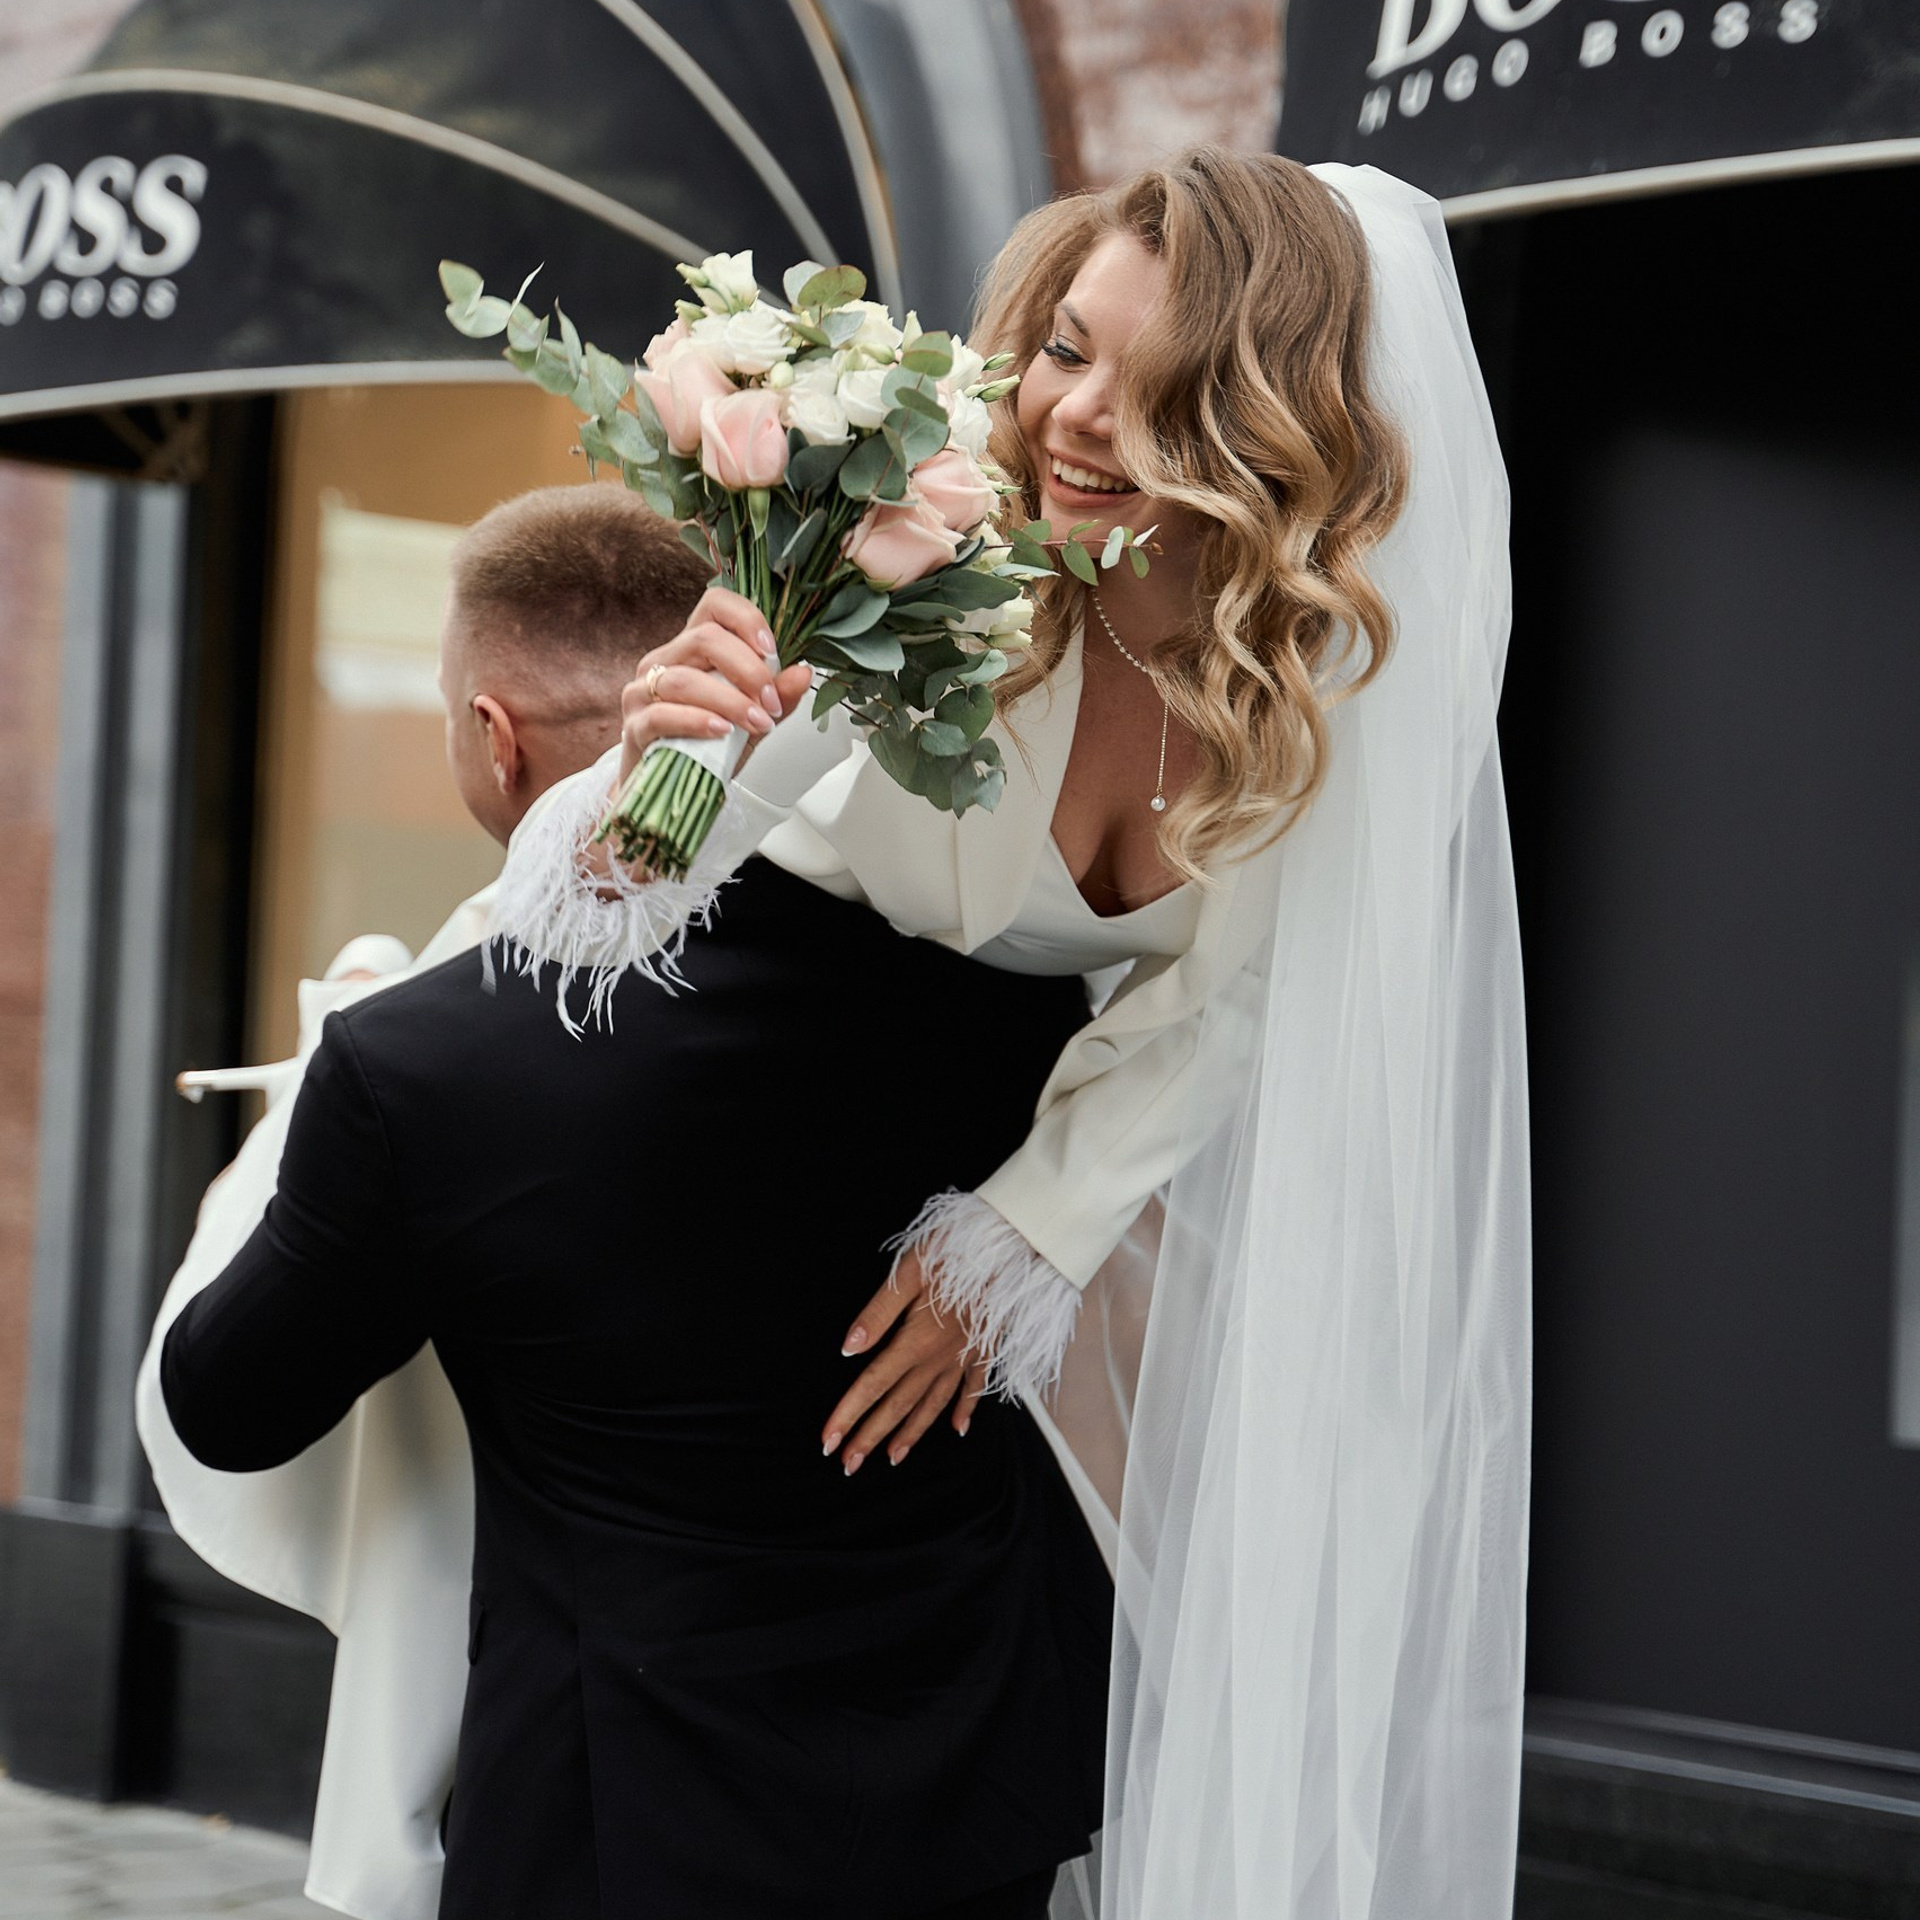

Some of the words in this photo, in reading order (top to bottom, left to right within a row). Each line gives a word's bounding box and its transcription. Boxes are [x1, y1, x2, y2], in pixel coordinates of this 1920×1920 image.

[1357, 38, 1529, 136] HUGO
[1579, 0, 1818, 69] BOSS
[0, 154, 208, 286] OSS
